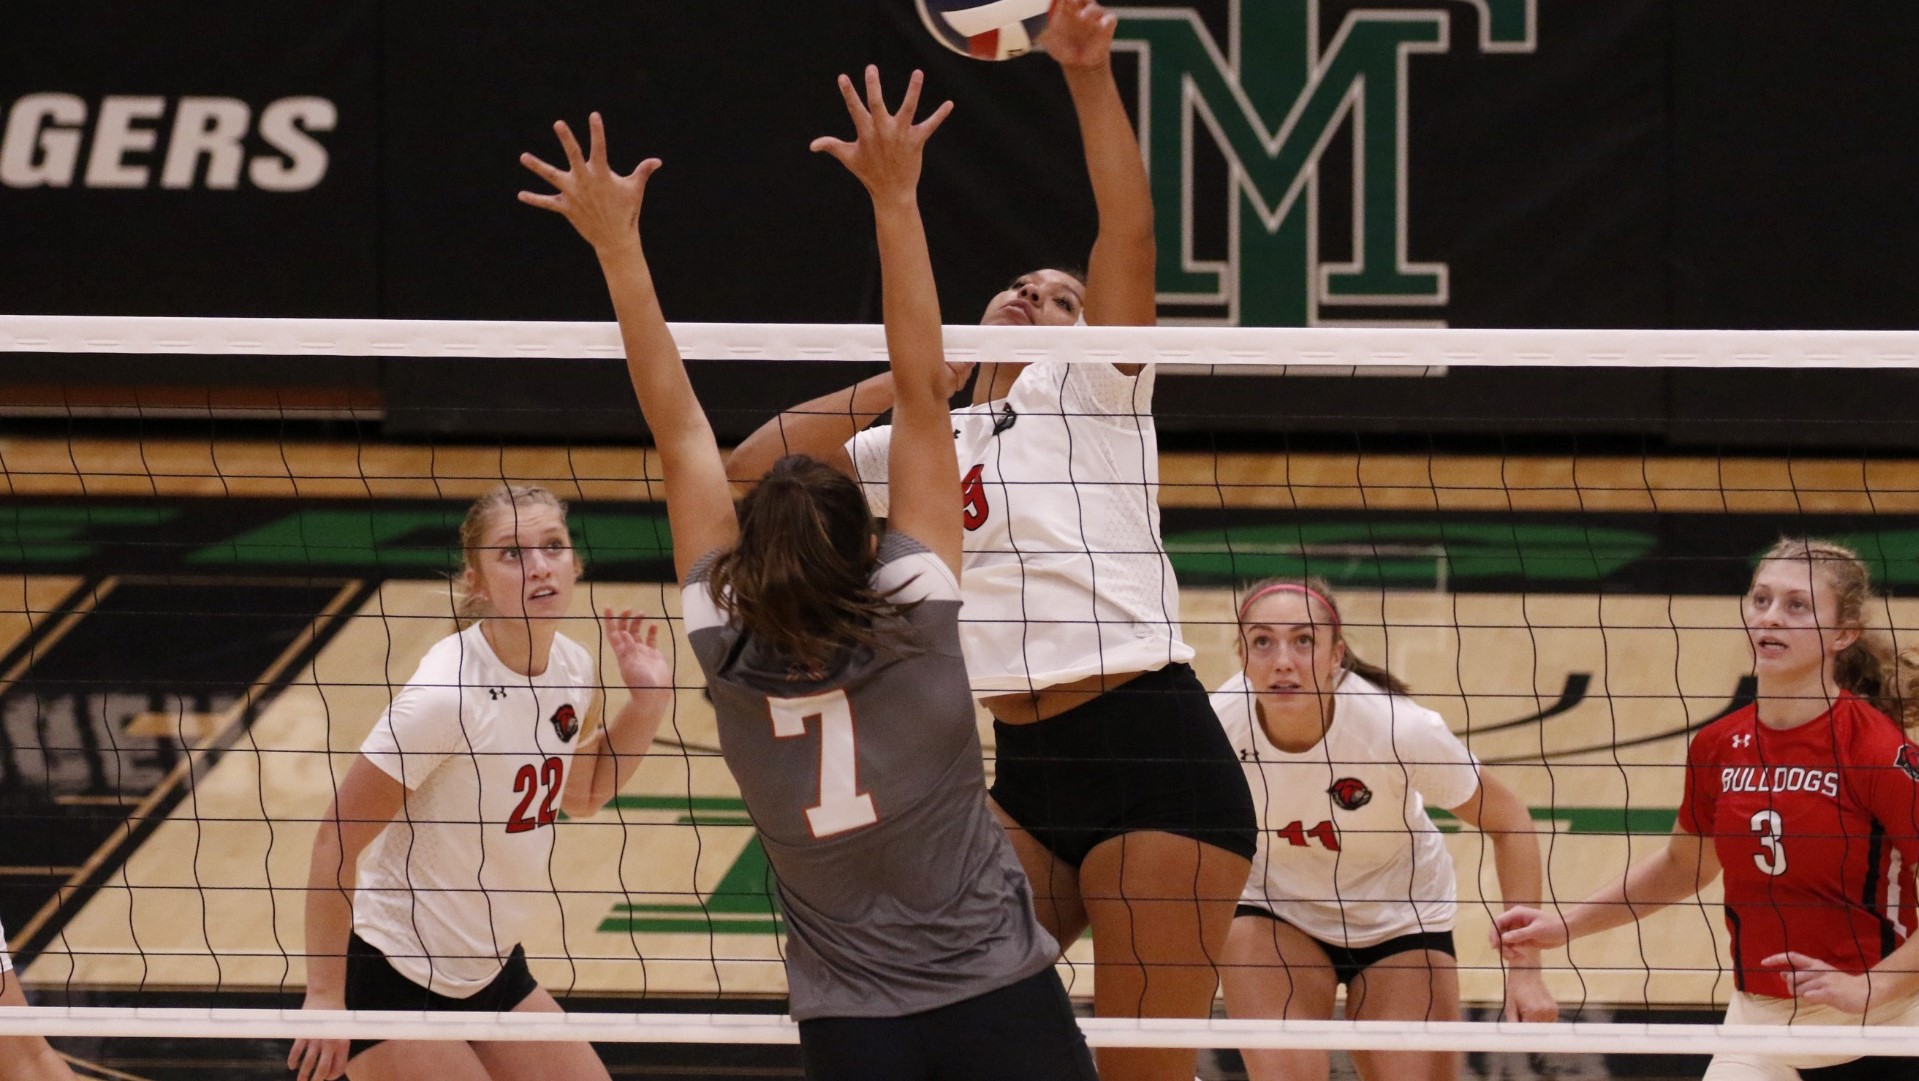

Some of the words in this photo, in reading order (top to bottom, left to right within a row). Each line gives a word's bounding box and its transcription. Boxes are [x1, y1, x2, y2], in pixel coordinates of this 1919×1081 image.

[0, 92, 338, 192] GERS
[505, 756, 564, 833] 22
[765, 685, 880, 839] 7
[1721, 766, 1840, 797] BULLDOGS
[1750, 809, 1788, 876] 3
